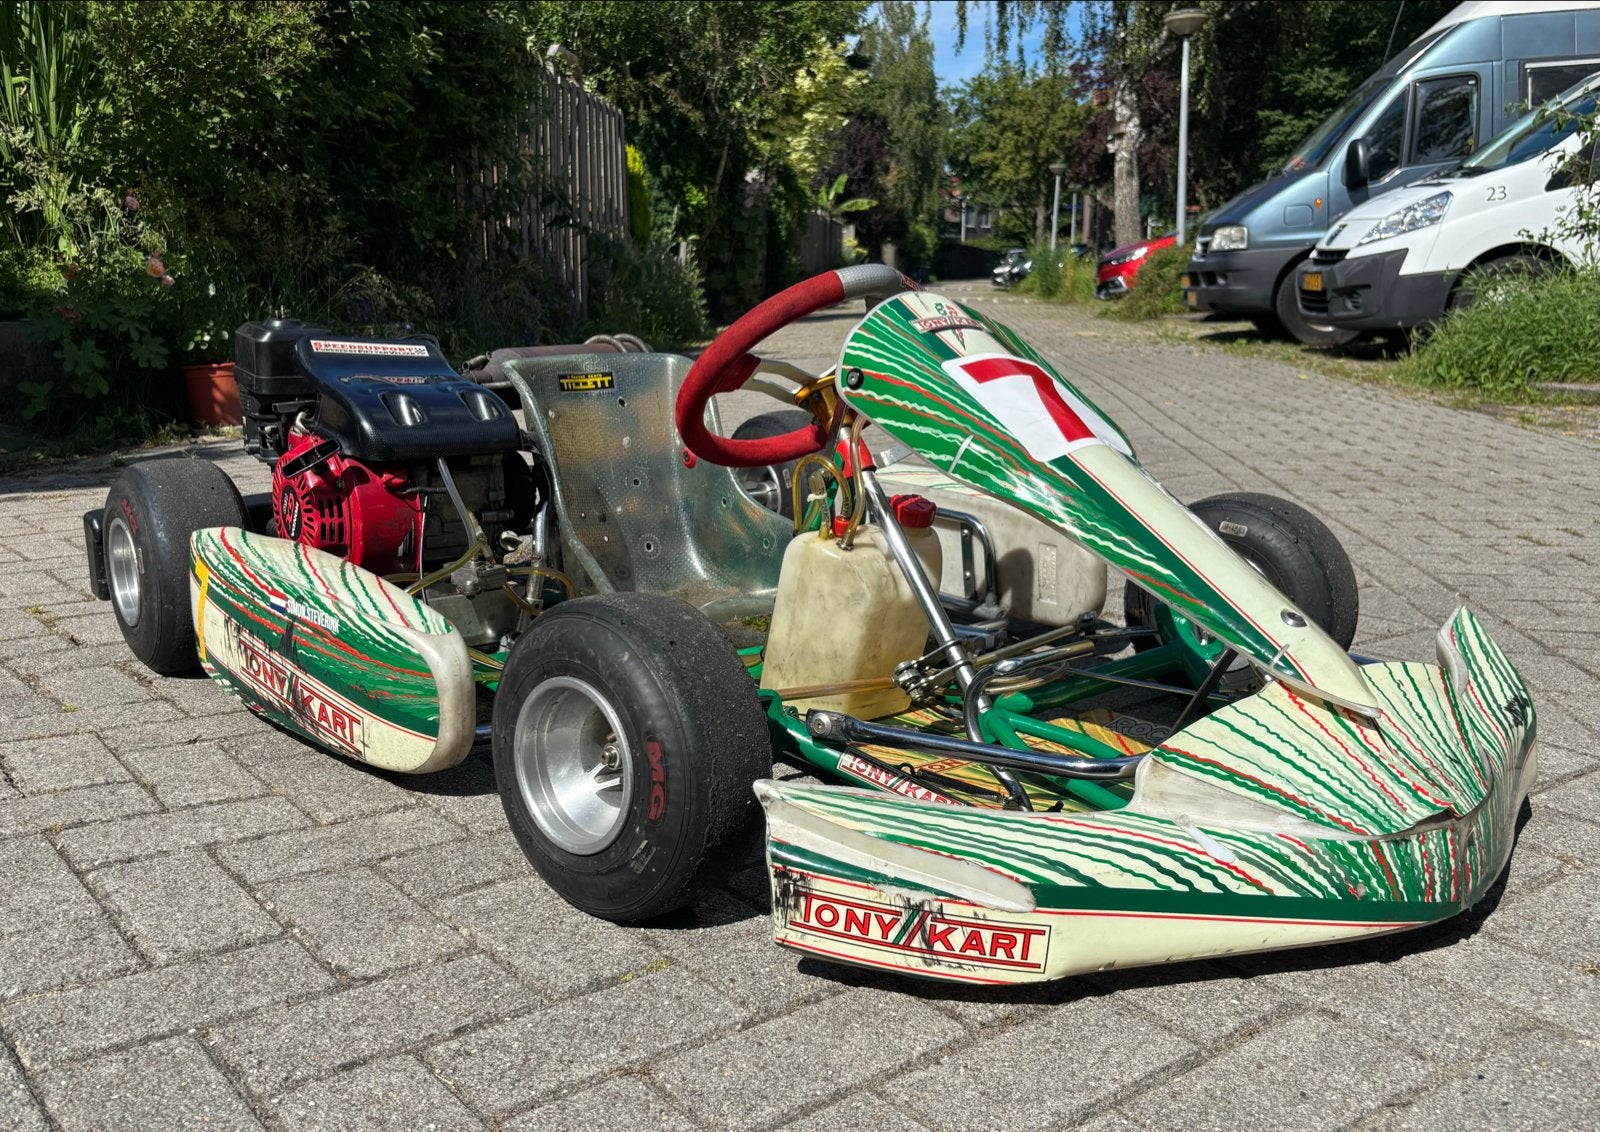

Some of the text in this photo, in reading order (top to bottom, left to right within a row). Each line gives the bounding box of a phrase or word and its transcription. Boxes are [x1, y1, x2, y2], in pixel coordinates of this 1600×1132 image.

[1486, 185, 1506, 201] 23
[959, 357, 1097, 443] 7
[239, 637, 361, 744] TONY KART
[646, 741, 665, 821] MG
[795, 891, 1046, 961] TONY KART
